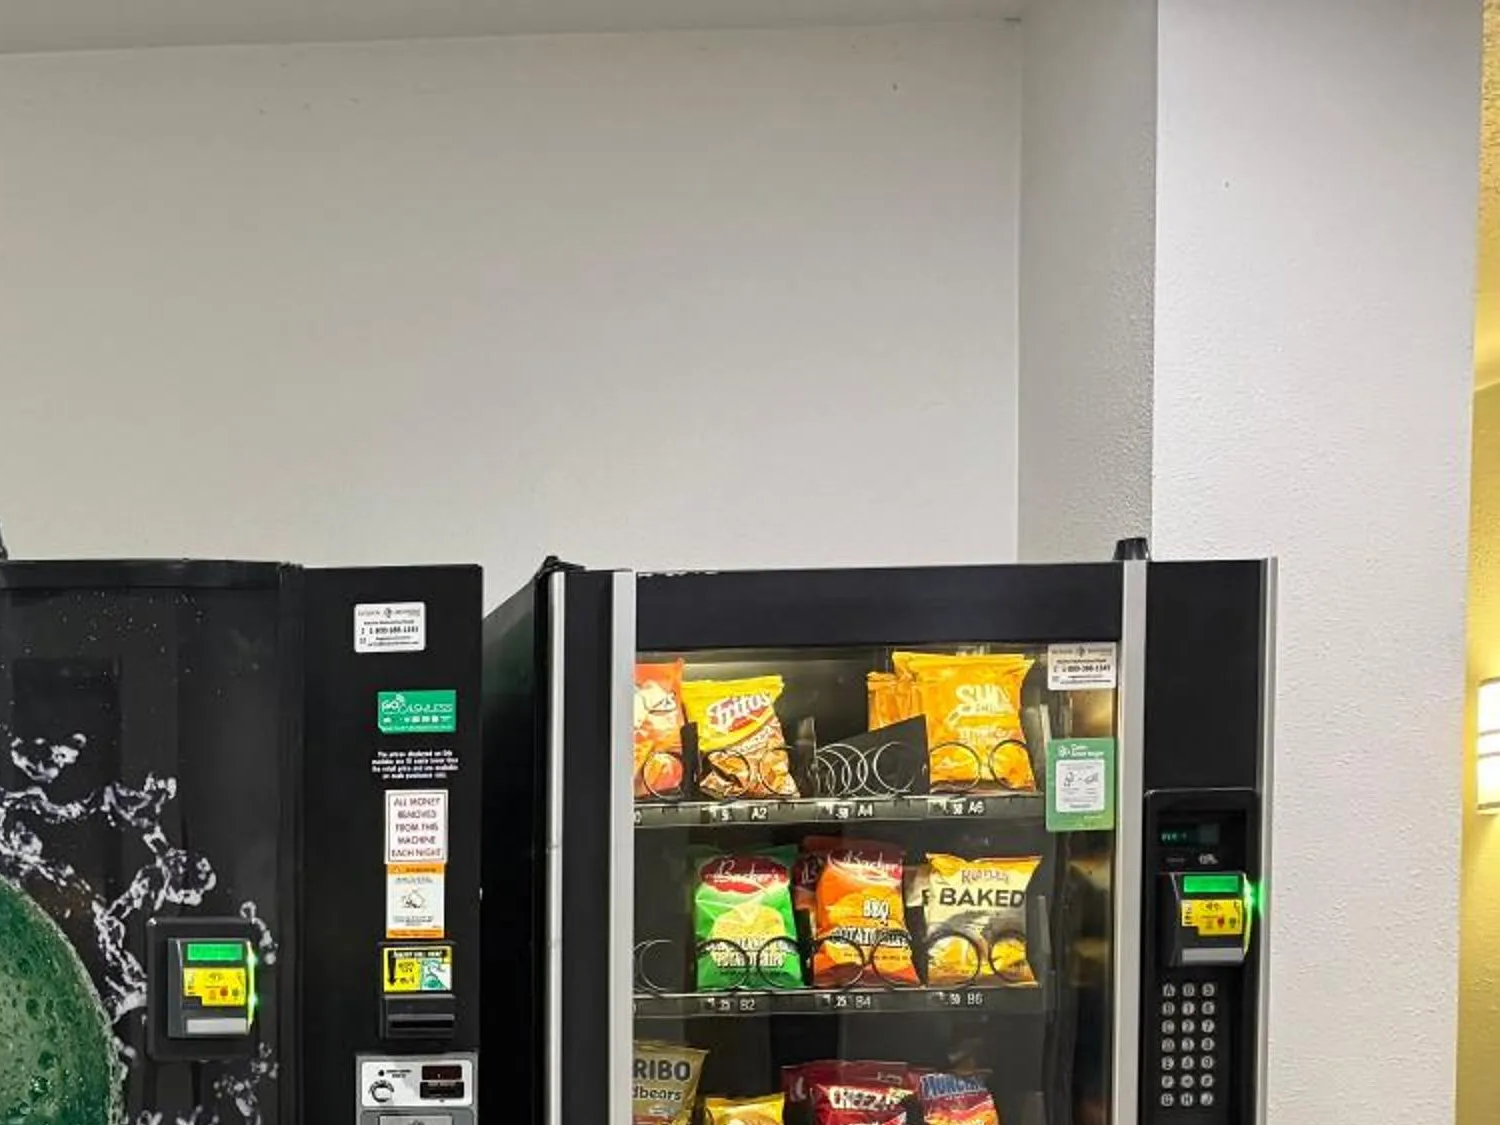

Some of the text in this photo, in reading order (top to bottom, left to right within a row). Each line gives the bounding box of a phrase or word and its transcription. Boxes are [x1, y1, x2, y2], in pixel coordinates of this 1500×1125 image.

[708, 691, 772, 731] Fritos
[409, 797, 441, 806] MONEY
[751, 807, 767, 821] A2
[857, 802, 873, 817] A4
[938, 888, 1025, 908] BAKED
[855, 995, 871, 1009] B4
[633, 1059, 691, 1081] RIBO
